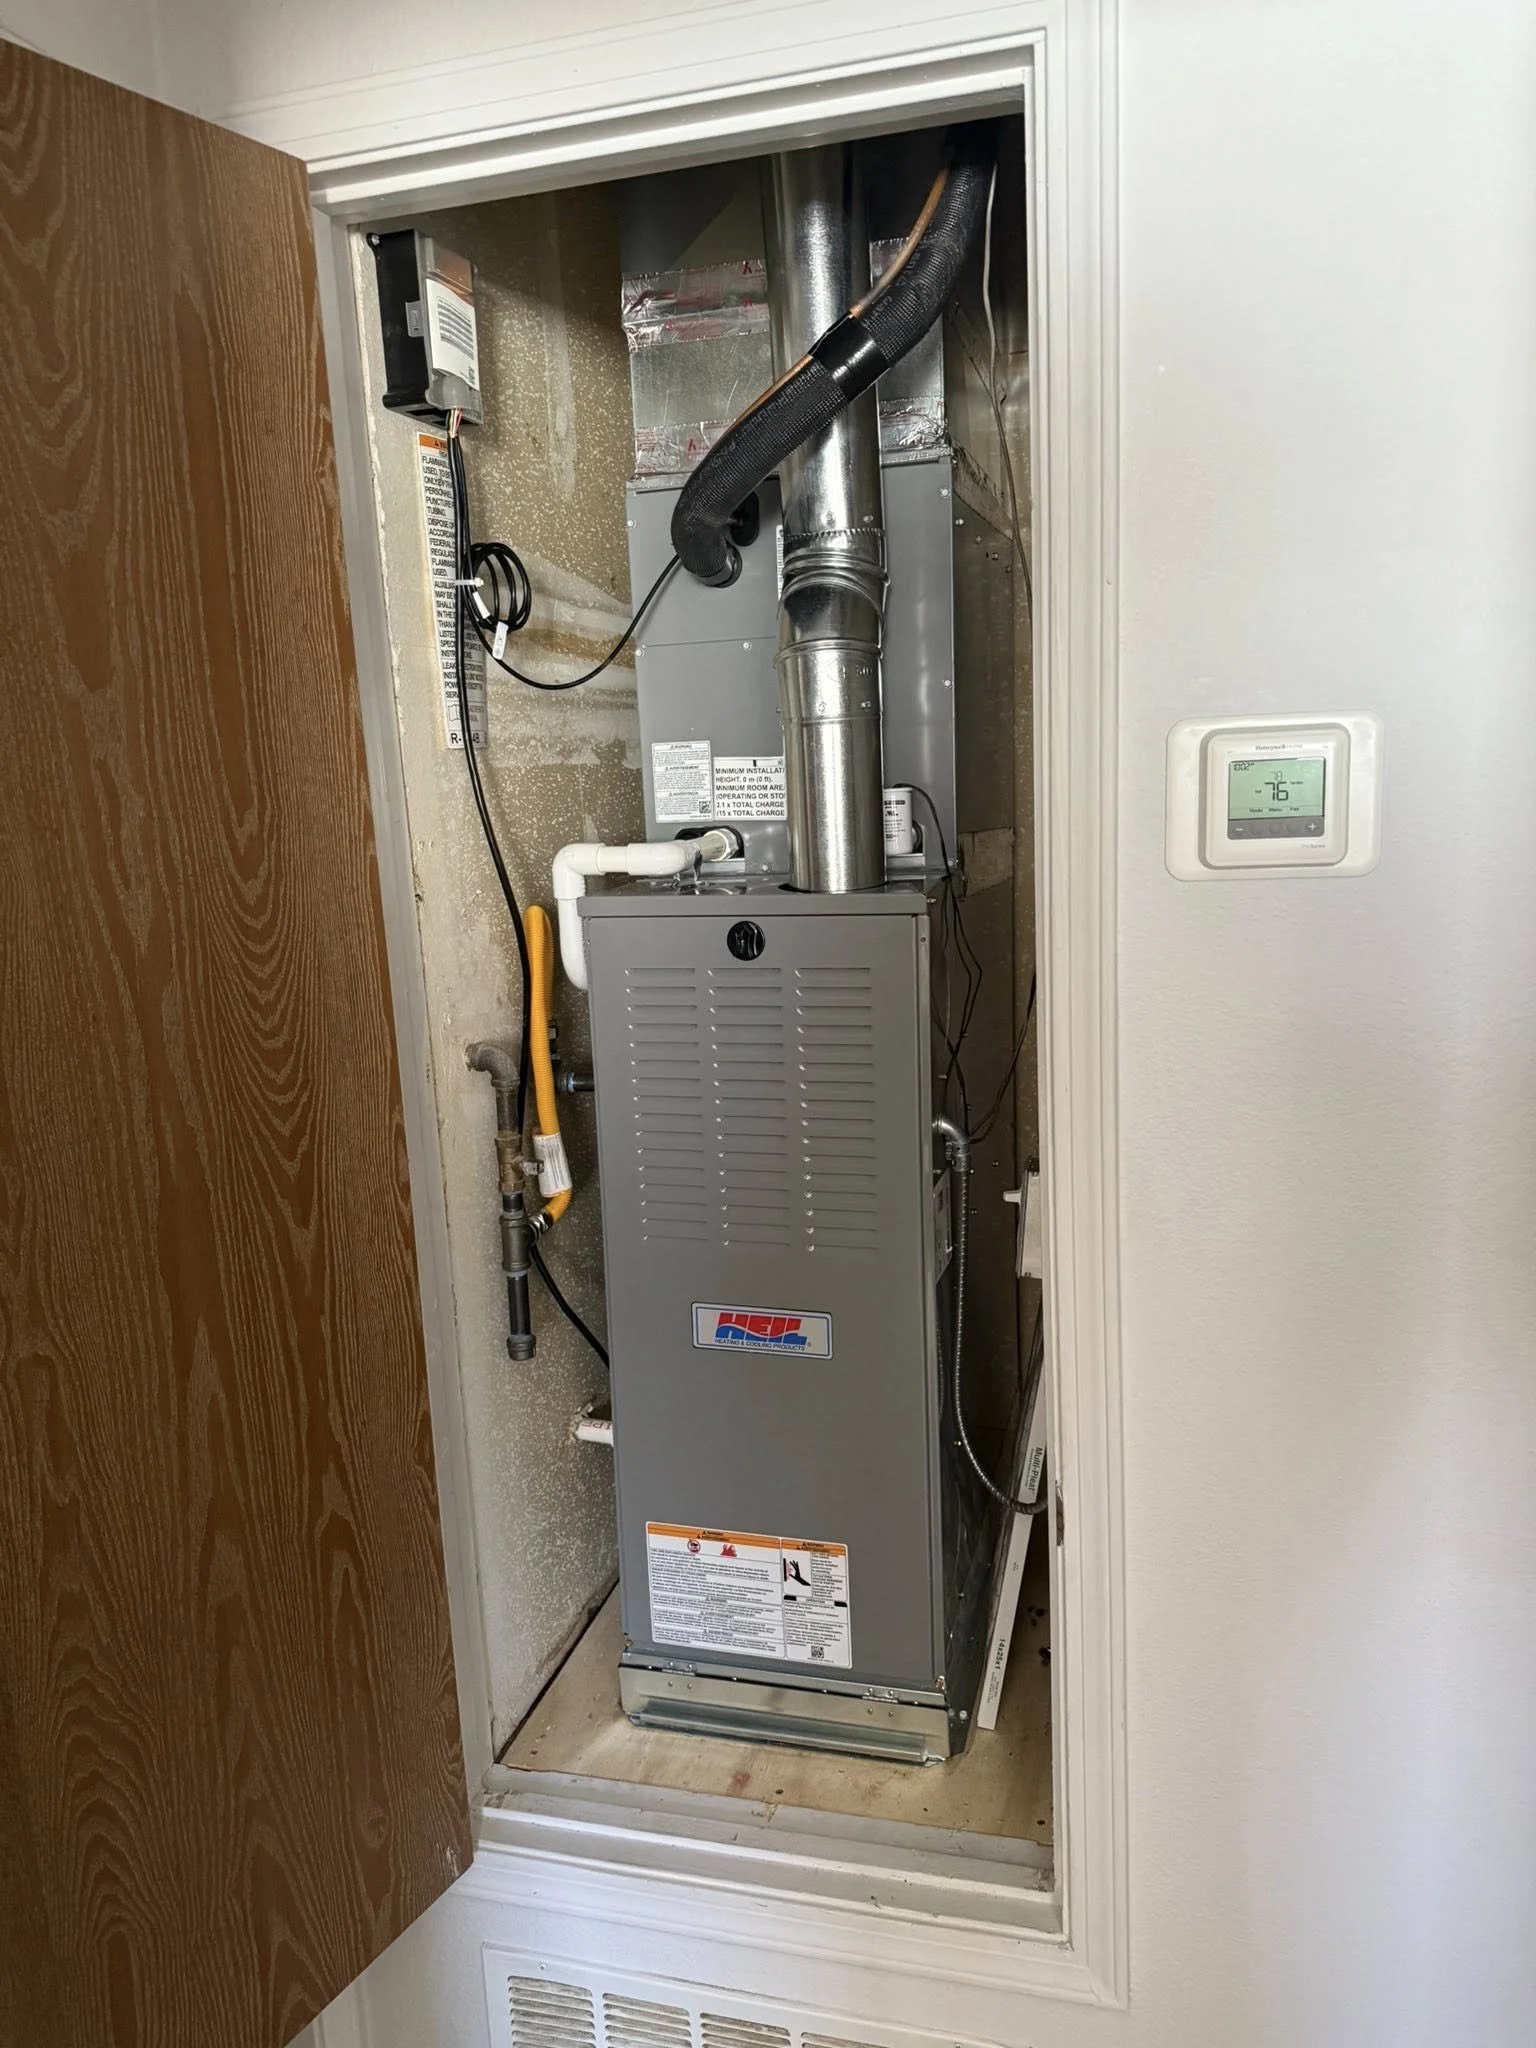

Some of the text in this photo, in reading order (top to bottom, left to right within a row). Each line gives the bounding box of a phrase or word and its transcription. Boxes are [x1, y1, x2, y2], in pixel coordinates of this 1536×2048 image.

[1264, 781, 1288, 801] 76
[715, 1312, 808, 1346] HEIL
[714, 1338, 740, 1346] HEATING
[745, 1341, 772, 1349] COOLING
[772, 1343, 806, 1351] PRODUCTS
[1028, 1446, 1043, 1491] Multi-Pleat
